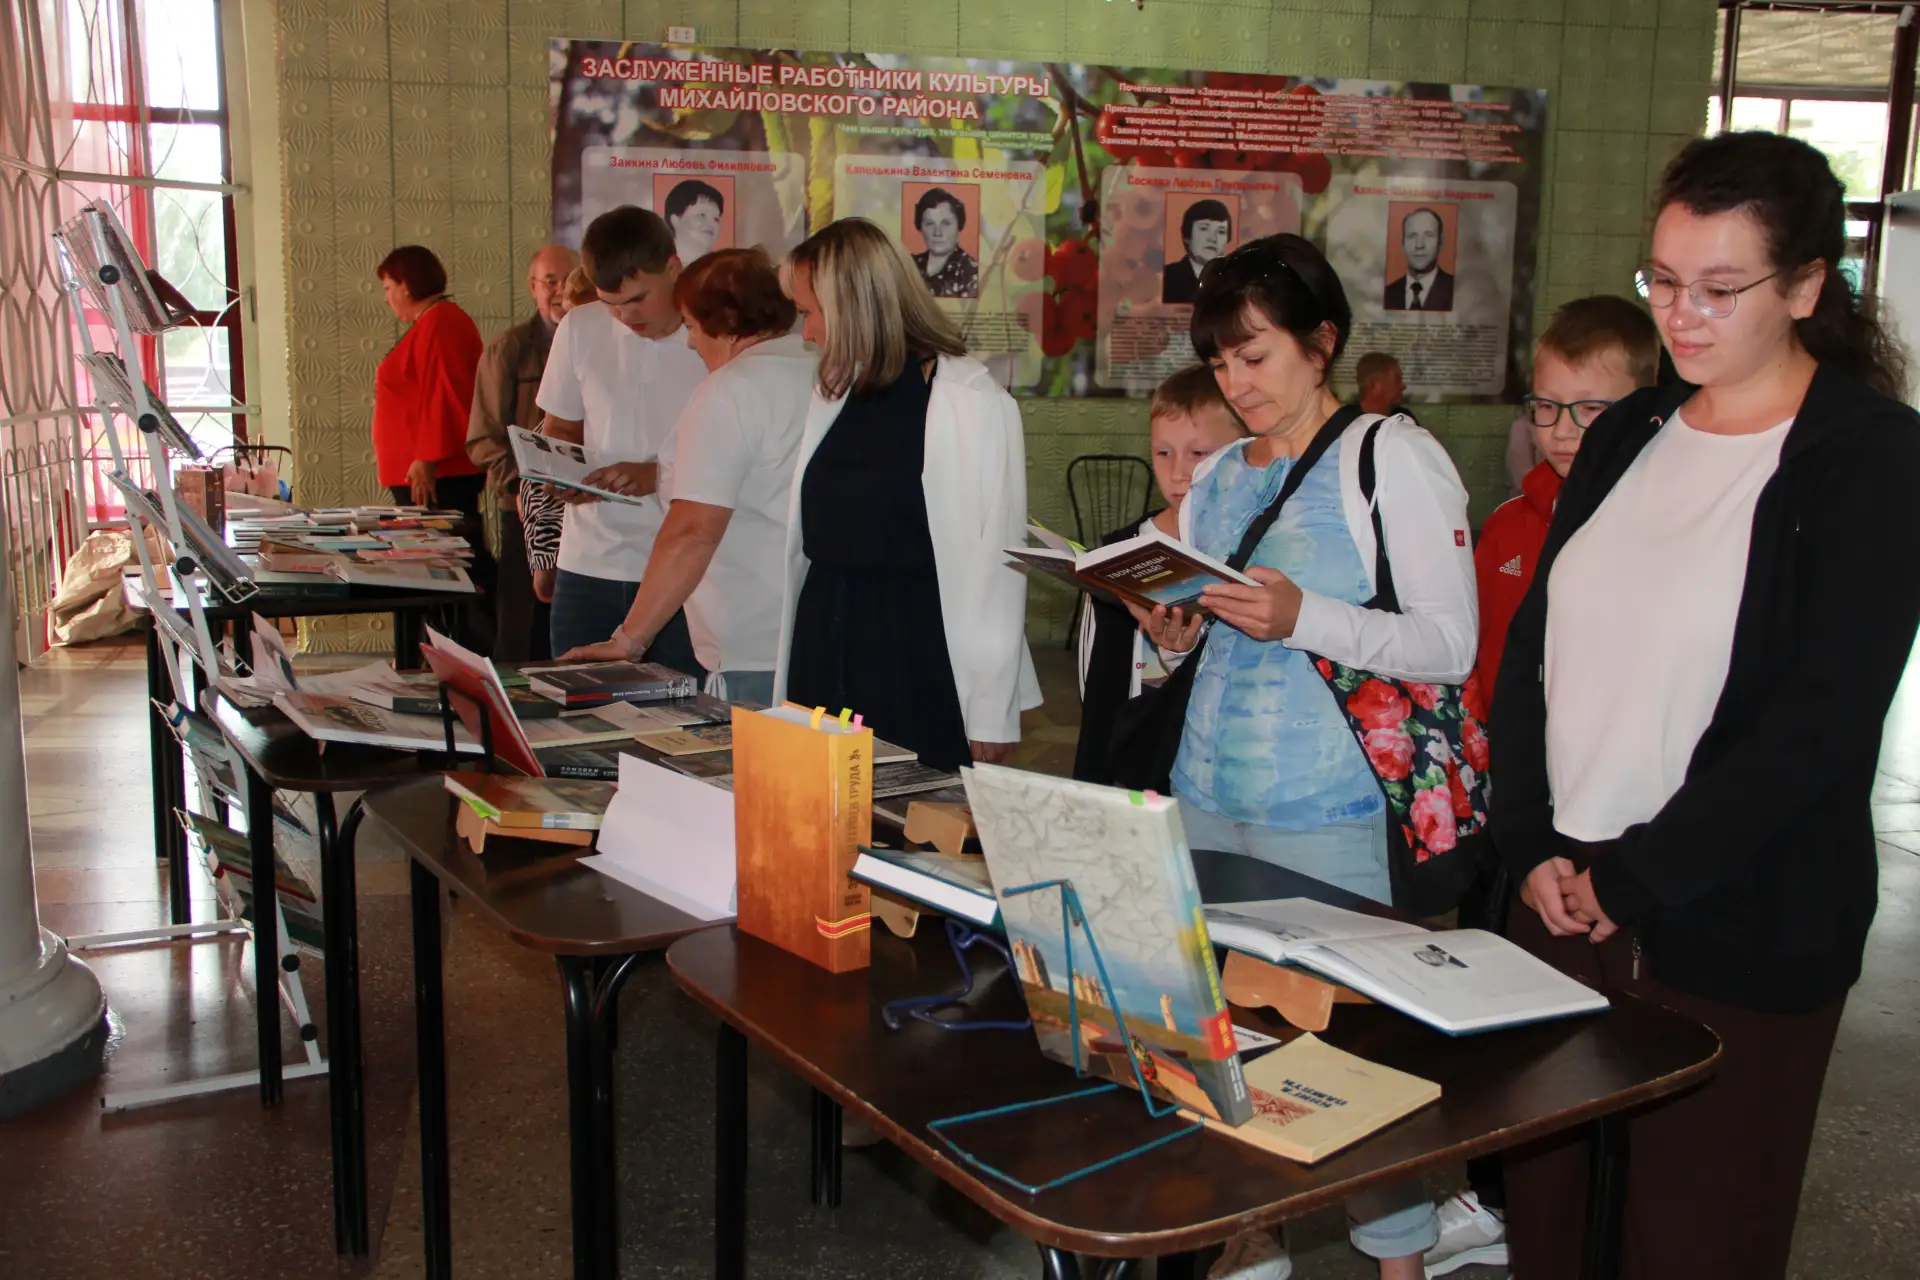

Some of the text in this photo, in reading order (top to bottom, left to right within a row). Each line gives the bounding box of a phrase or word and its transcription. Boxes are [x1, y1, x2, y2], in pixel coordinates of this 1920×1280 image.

[582, 57, 1051, 98] ЗАСЛУЖЕННЫЕ РАБОТНИКИ КУЛЬТУРЫ
[660, 86, 979, 119] МИХАЙЛОВСКОГО РАЙОНА
[610, 156, 659, 168] Заикина
[661, 158, 704, 170] Любовь
[912, 165, 969, 179] Валентина
[848, 764, 861, 799] ТРУДА
[1281, 1079, 1348, 1106] ПАМЯТИ
[1281, 1086, 1332, 1107] КНИГА
